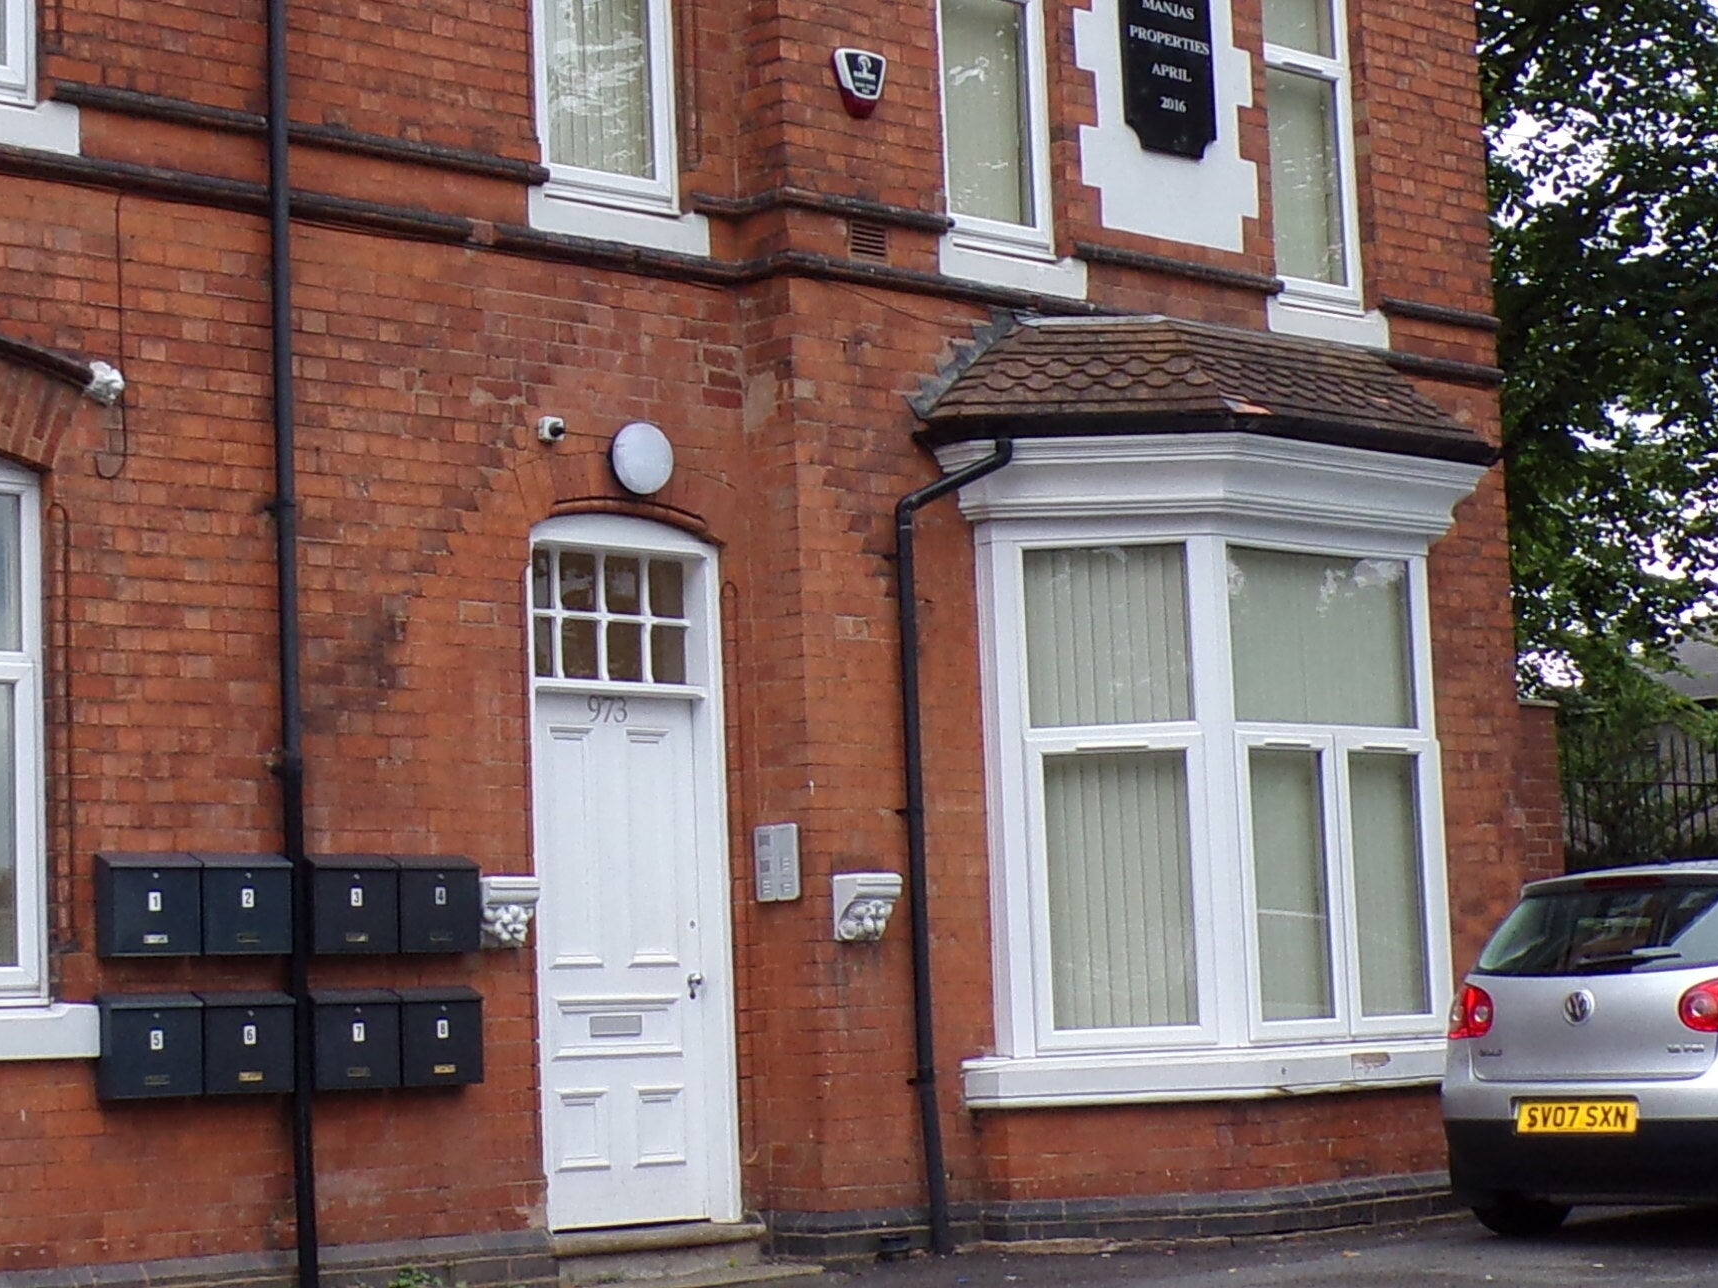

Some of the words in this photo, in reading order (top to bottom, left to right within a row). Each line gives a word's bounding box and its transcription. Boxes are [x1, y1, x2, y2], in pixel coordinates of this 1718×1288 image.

[1129, 24, 1210, 56] PROPERTIES
[1151, 62, 1192, 83] APRIL
[1159, 95, 1187, 114] 2016
[586, 695, 628, 723] 973
[153, 895, 159, 908] 1
[245, 891, 252, 905] 2
[353, 891, 360, 903] 3
[437, 890, 444, 902] 4
[246, 1028, 253, 1042] 6
[355, 1026, 362, 1039] 7
[440, 1023, 446, 1035] 8
[153, 1033, 160, 1046] 5
[1527, 1106, 1581, 1129] SV07
[1585, 1105, 1628, 1128] SXN
